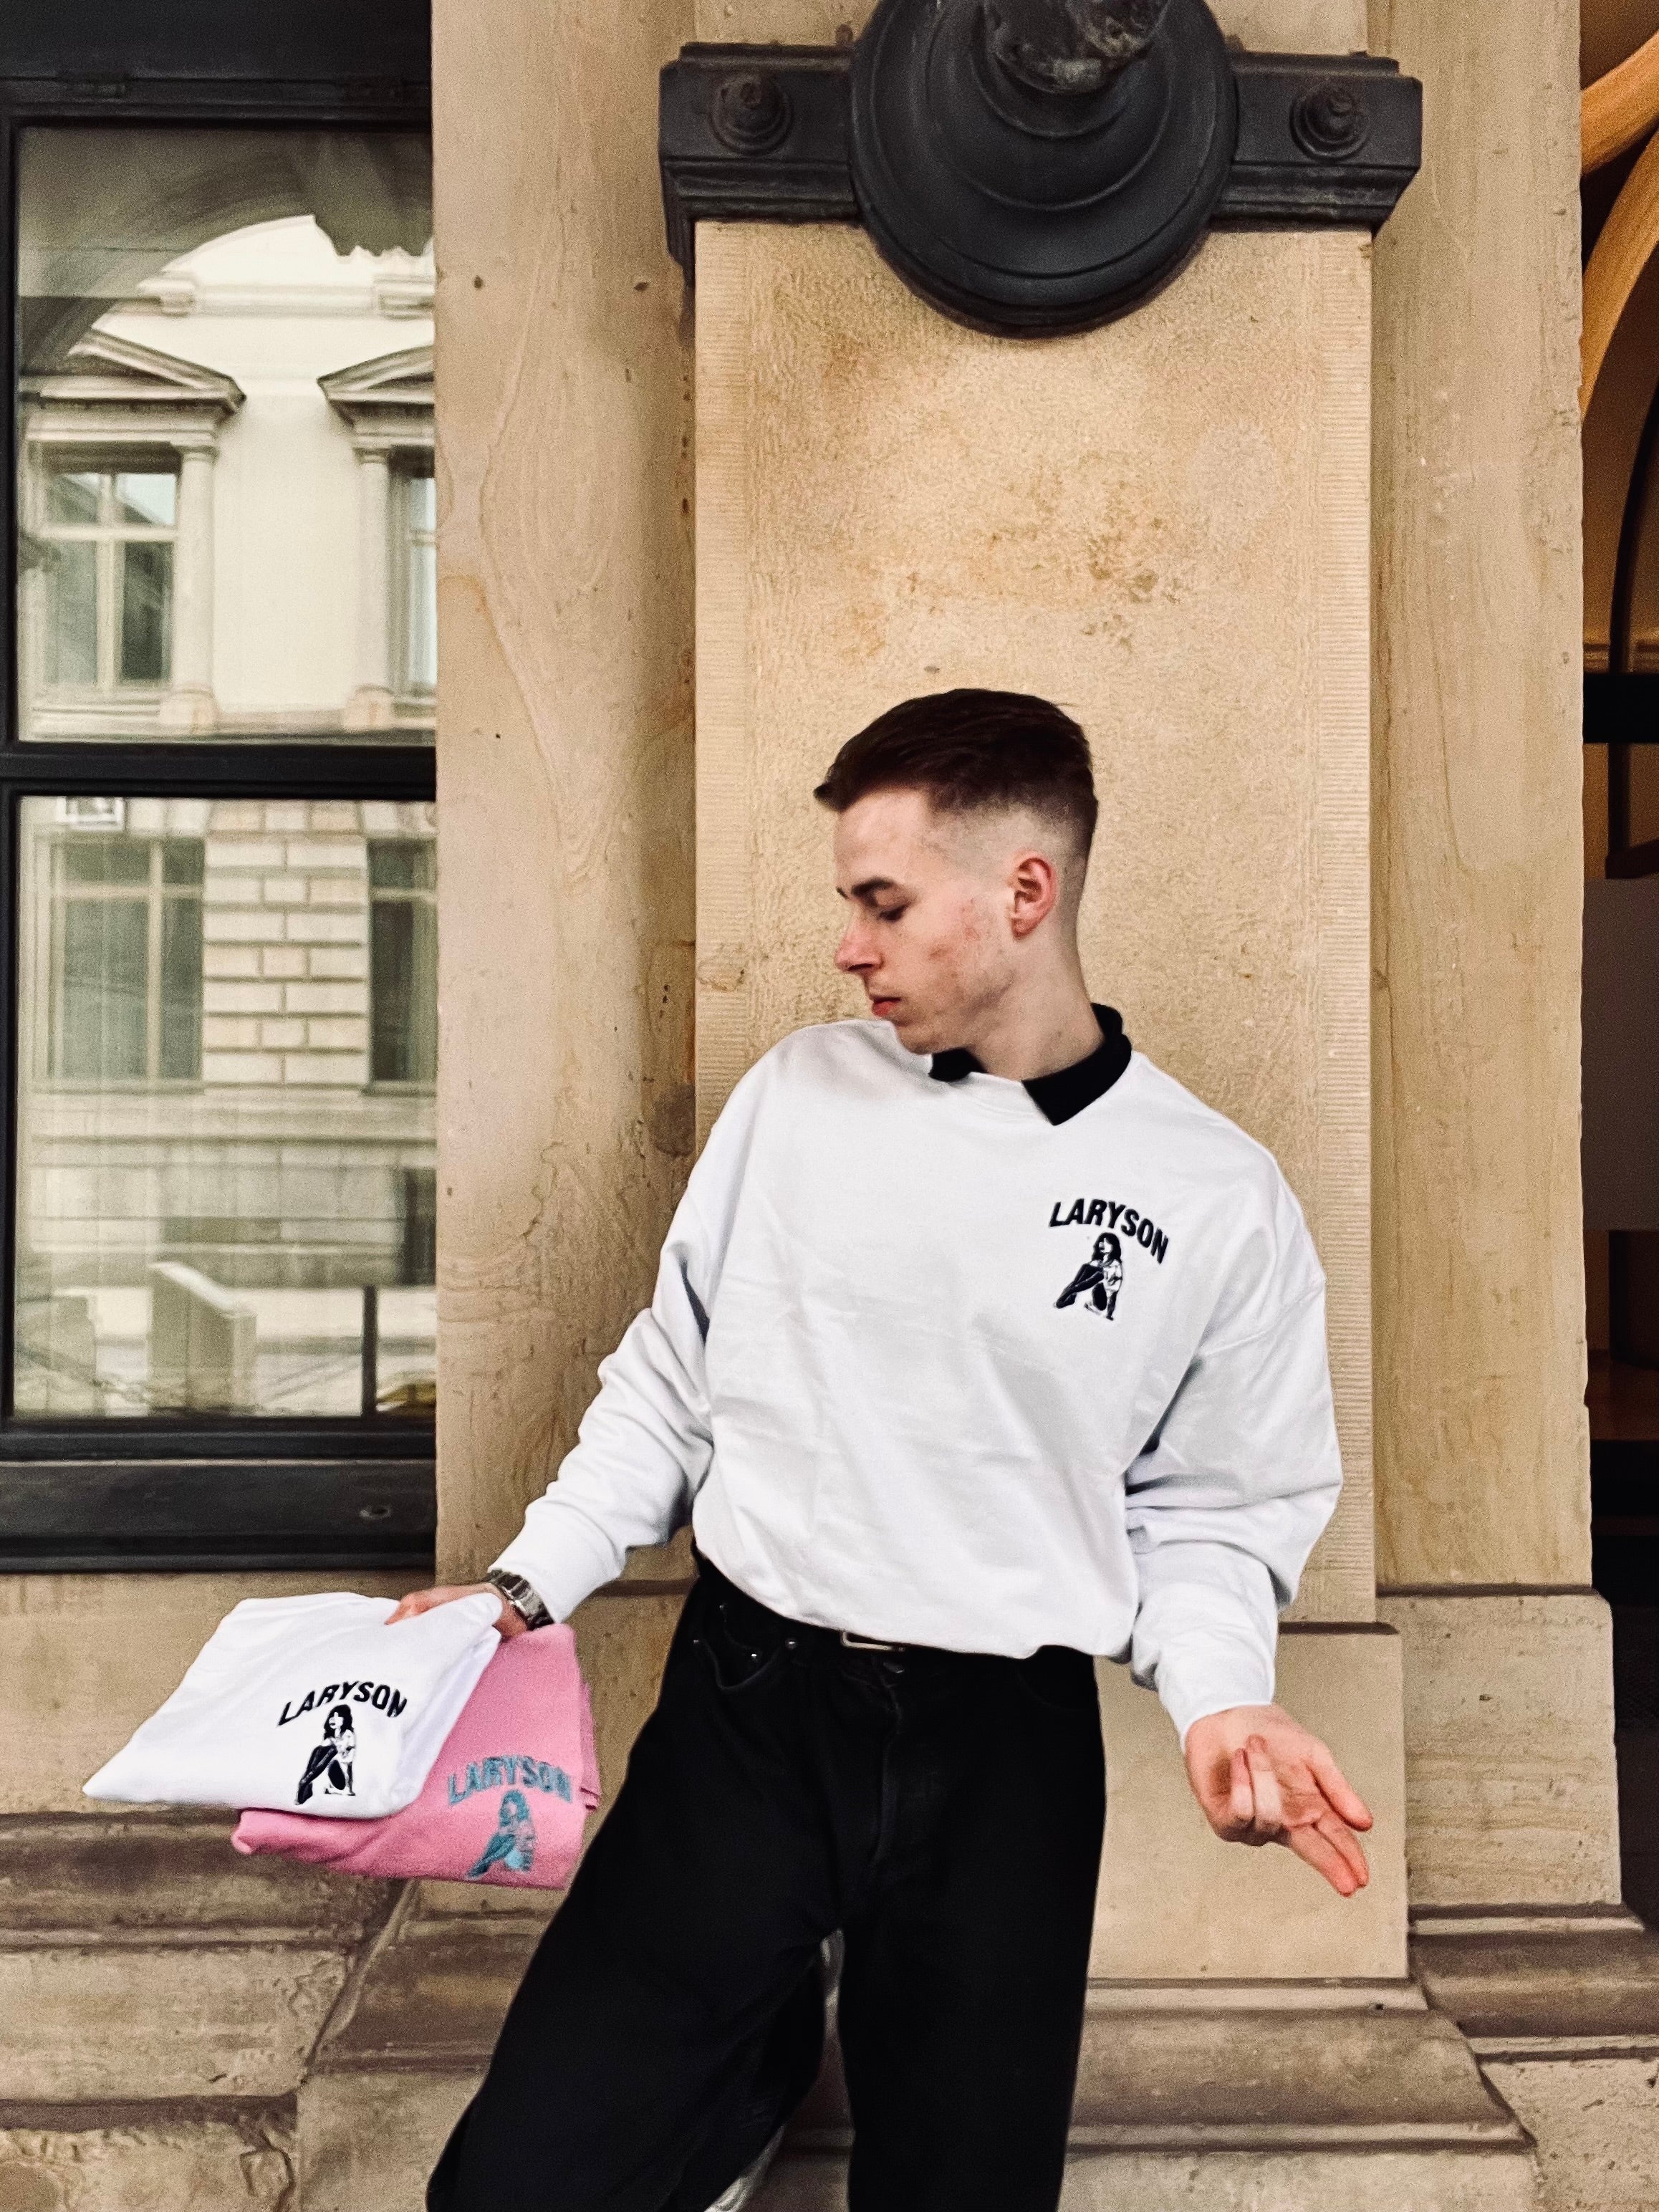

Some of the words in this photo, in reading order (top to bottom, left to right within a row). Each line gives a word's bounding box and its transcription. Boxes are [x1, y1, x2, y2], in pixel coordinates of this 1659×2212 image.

[1049, 1198, 1169, 1264] LARYSON
[277, 1680, 408, 1726] LARYSON
[448, 1755, 572, 1805] LARYSON
